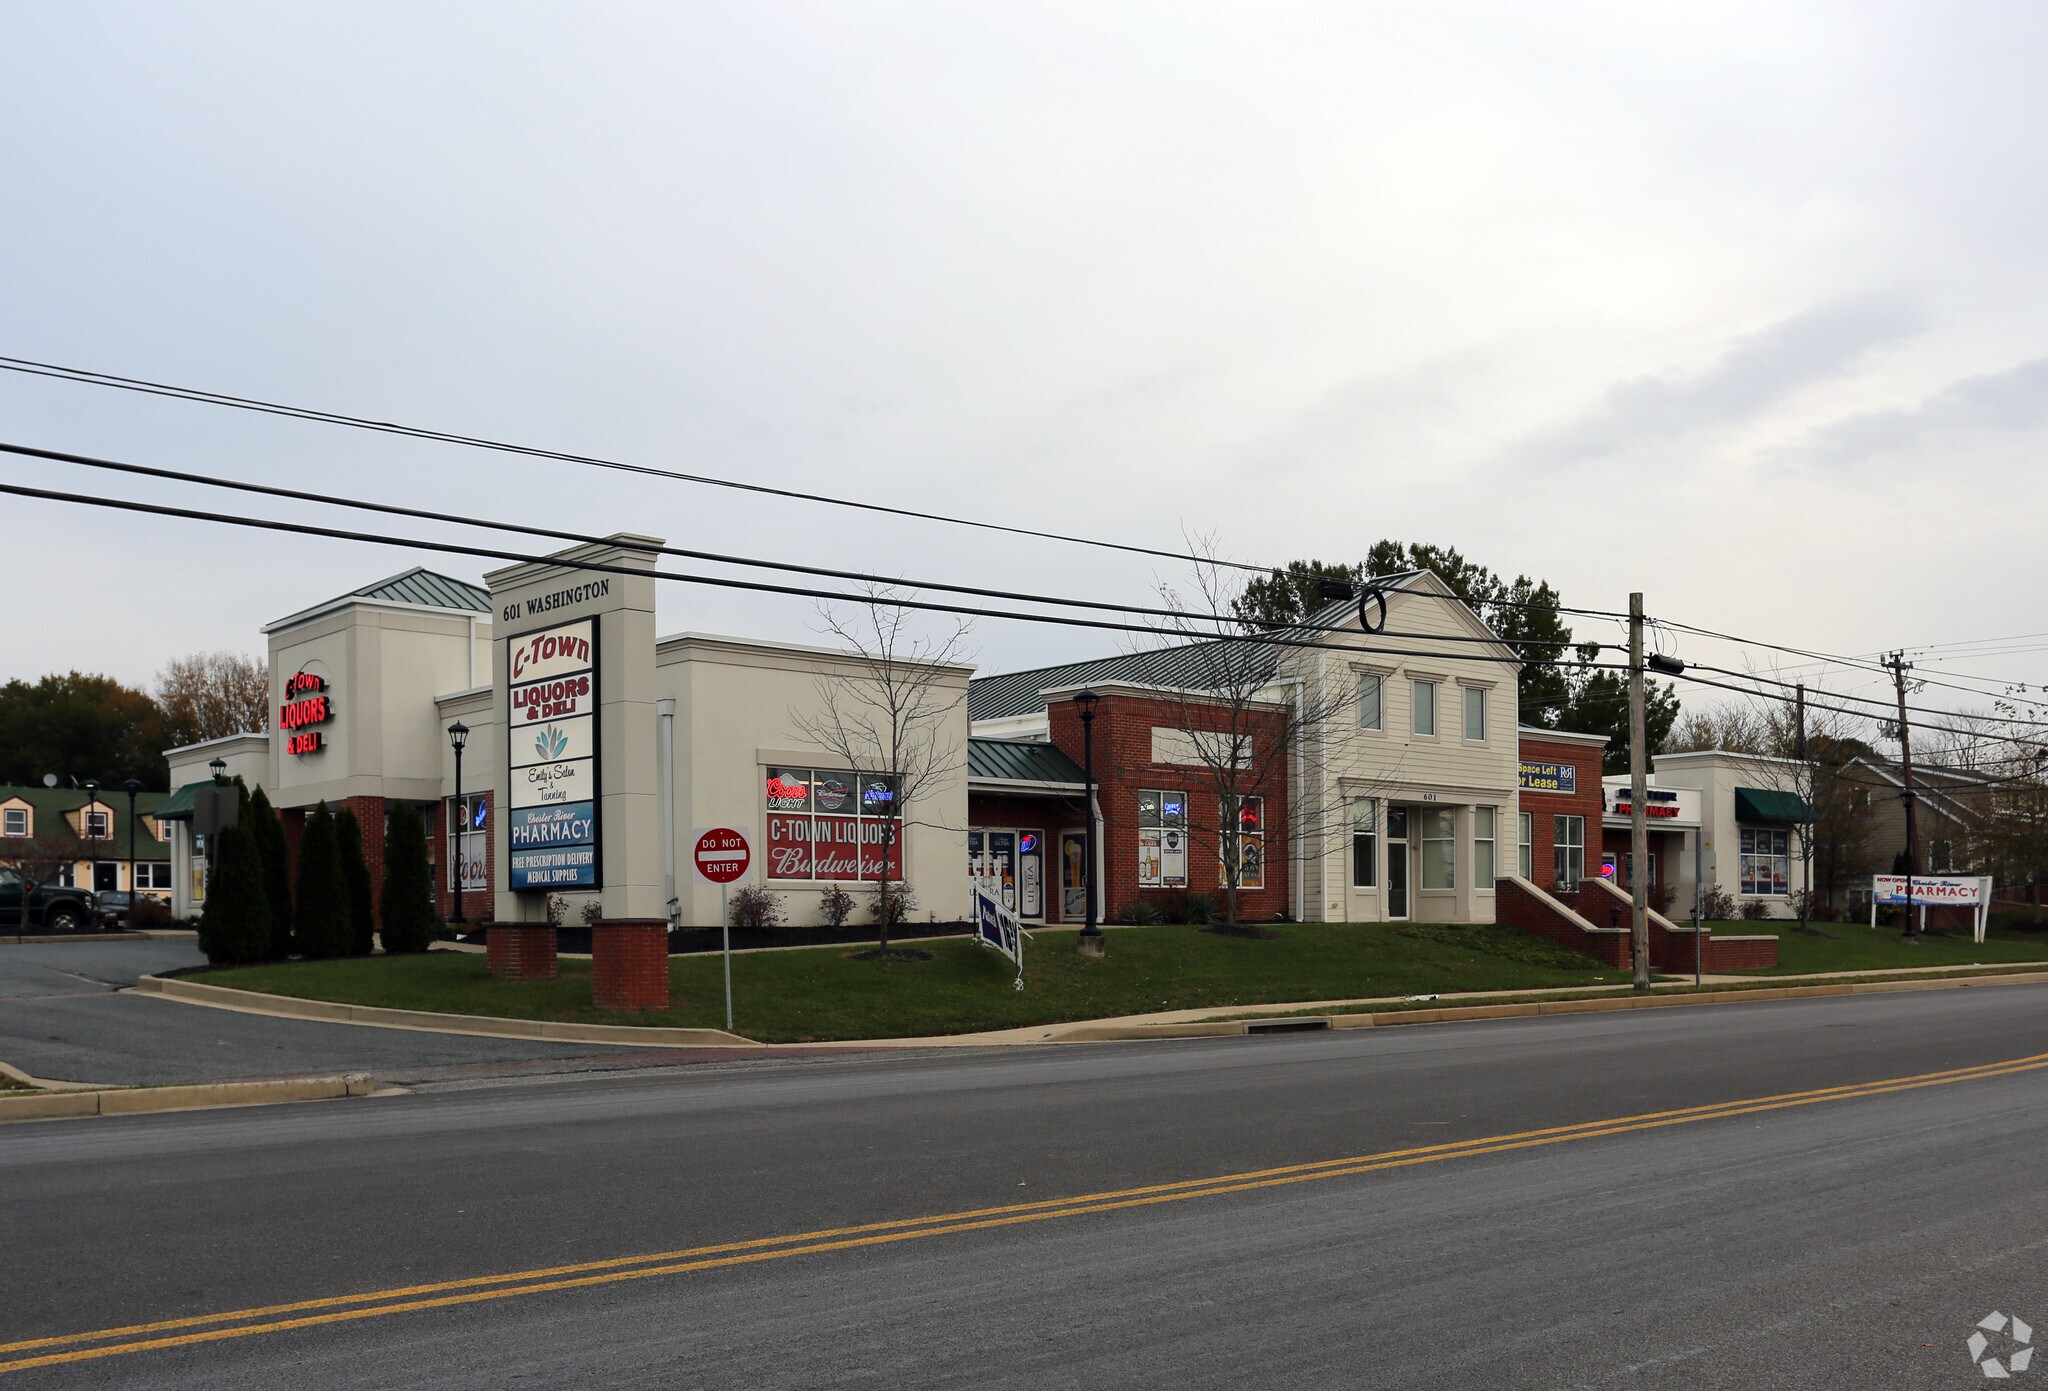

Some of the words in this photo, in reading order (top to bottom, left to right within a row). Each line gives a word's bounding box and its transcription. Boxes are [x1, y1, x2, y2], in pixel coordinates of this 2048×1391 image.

[503, 604, 520, 621] 601
[527, 579, 609, 615] WASHINGTON
[514, 677, 590, 709] LIQUORS
[280, 696, 326, 730] LIQUORS
[526, 706, 539, 720] &
[542, 699, 576, 718] DELI
[288, 737, 295, 754] &
[297, 732, 317, 753] DELI
[528, 766, 552, 783] Emily's
[553, 764, 575, 780] Salon
[1519, 763, 1540, 775] Space
[1541, 765, 1557, 775] Left
[766, 777, 807, 799] Coors
[1528, 775, 1558, 789] Lease
[538, 787, 567, 801] Tanning
[768, 797, 805, 808] LIGHT
[1423, 793, 1437, 801] 601
[527, 812, 553, 824] Chester
[553, 810, 576, 822] River
[1619, 803, 1680, 817] PHMACY
[513, 819, 592, 844] PHARMACY
[771, 819, 832, 843] C-TOWN
[702, 839, 716, 849] DO
[722, 838, 741, 848] NOT
[512, 857, 525, 869] FREE
[526, 853, 566, 868] PRESCRIPTION
[567, 851, 593, 866] DELIVERY
[707, 863, 739, 873] ENTER
[771, 847, 896, 875] Budweiser
[527, 870, 551, 884] MEDICAL
[552, 868, 578, 882] SUPPLIES
[1027, 864, 1035, 903] ULTRA
[1896, 885, 1979, 897] PHARMACY
